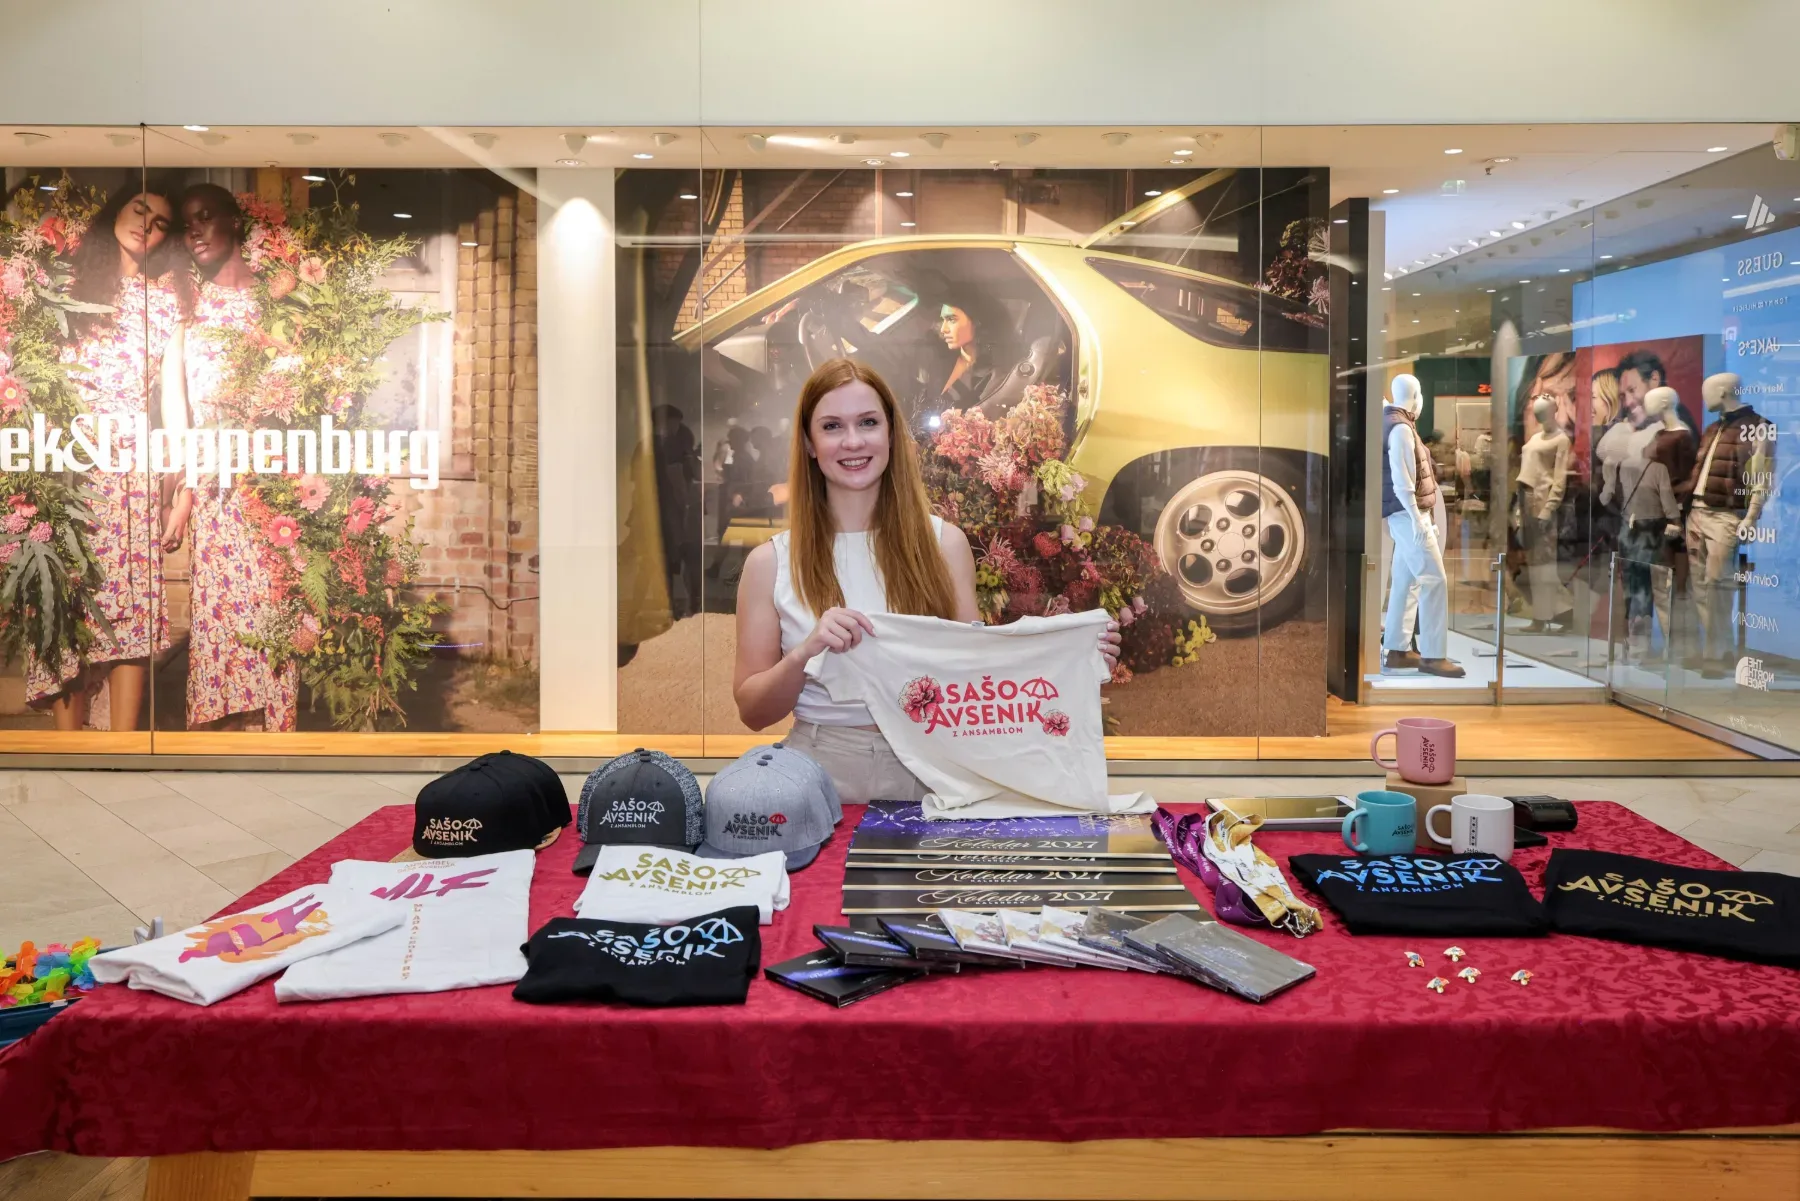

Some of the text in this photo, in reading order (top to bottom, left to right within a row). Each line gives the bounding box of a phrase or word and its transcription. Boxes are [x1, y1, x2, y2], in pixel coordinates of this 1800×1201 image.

[946, 675, 1019, 704] SAŠO
[925, 700, 1046, 735] AVSENIK
[952, 727, 1024, 738] Z ANSAMBLOM
[1421, 735, 1431, 770] AVSENIK
[1429, 743, 1437, 763] SAŠO
[612, 797, 647, 811] SAŠO
[430, 816, 463, 830] SAŠO
[599, 809, 660, 825] AVSENIK
[733, 812, 769, 825] SAŠO
[421, 825, 478, 842] AVSENIK
[722, 820, 782, 837] AVSENIK
[1038, 840, 1099, 849] 2027
[636, 853, 717, 880] SAŠO
[1340, 855, 1445, 871] SAŠO
[598, 867, 746, 891] AVSENIK
[1041, 871, 1103, 881] 2027
[1316, 867, 1503, 886] AVSENIK
[639, 884, 713, 896] ANSAMBLOM
[1356, 883, 1465, 893] Z ANSAMBLOM
[1604, 872, 1711, 899] SAŠO
[917, 889, 1114, 904] Koledar 2027
[1557, 875, 1756, 922] AVSENIK
[1611, 898, 1709, 918] ANSAMBLOM
